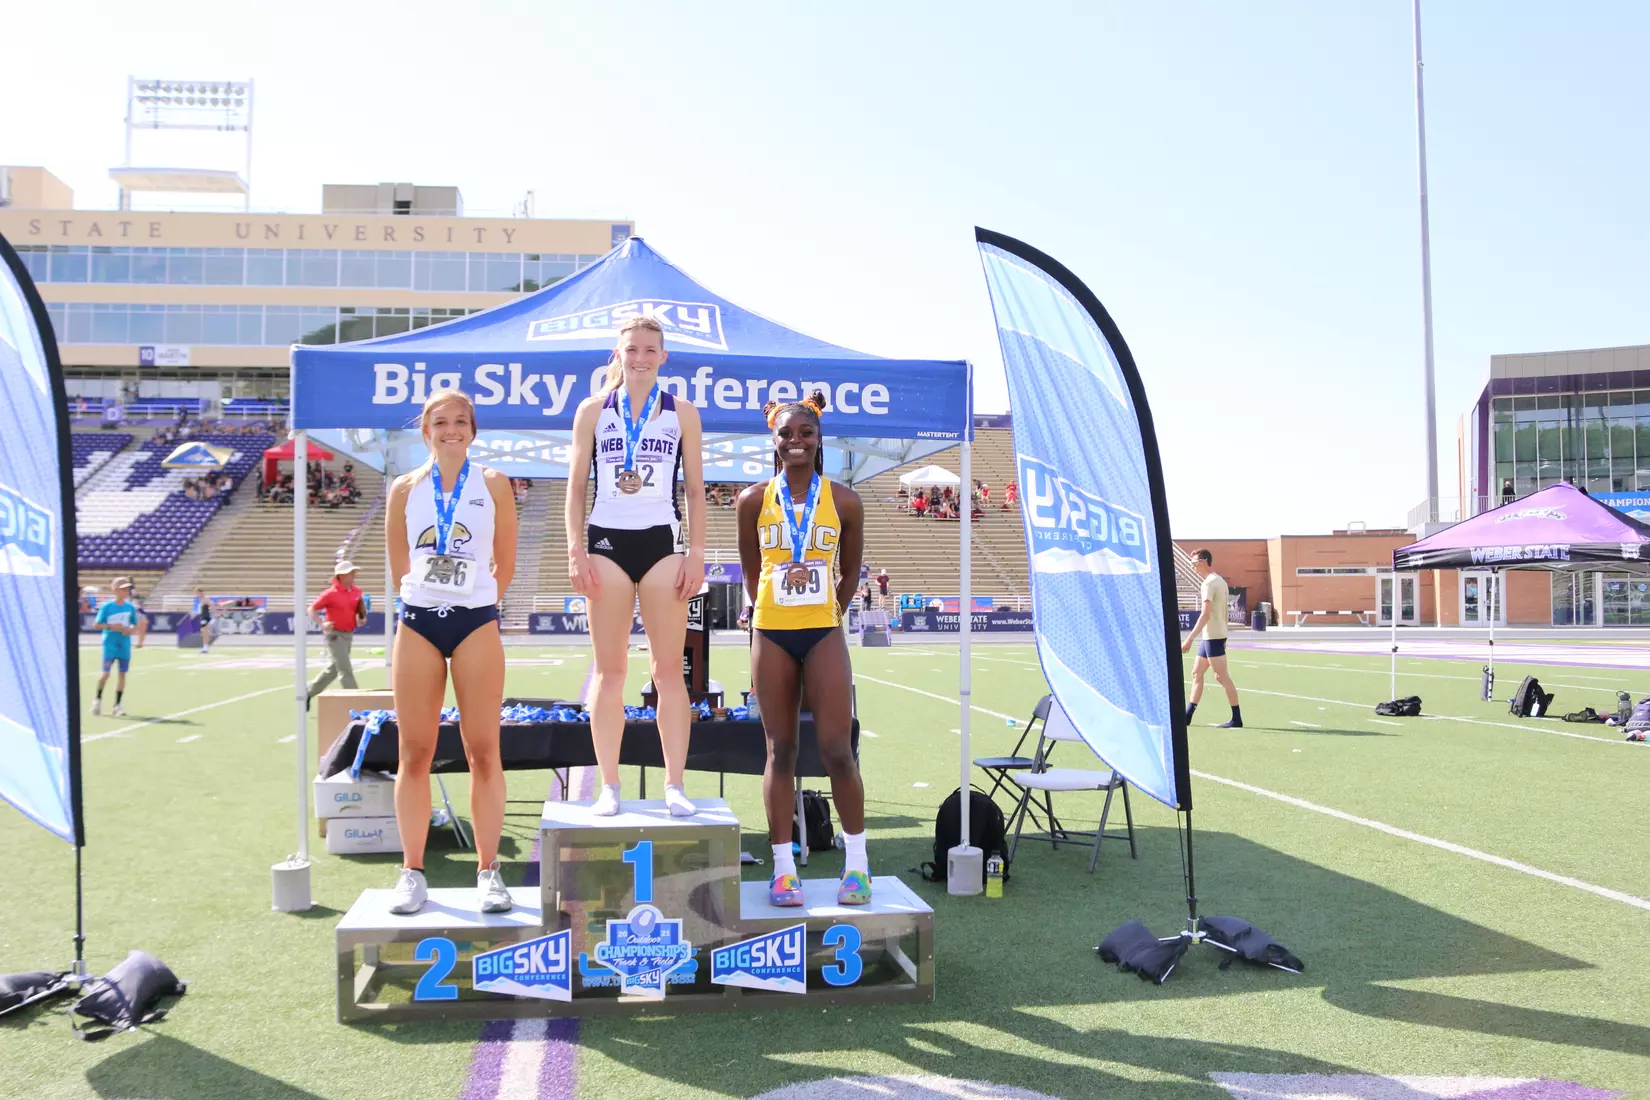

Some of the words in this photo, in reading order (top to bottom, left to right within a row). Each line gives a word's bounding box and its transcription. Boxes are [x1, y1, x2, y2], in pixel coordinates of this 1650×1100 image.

[29, 219, 162, 238] STATE
[235, 222, 517, 245] UNIVERSITY
[475, 363, 577, 416] Sky
[590, 365, 890, 414] nference
[916, 431, 960, 439] MASTERTENT
[601, 438, 623, 453] WEB
[641, 438, 674, 455] STATE
[615, 464, 655, 487] 52
[1469, 546, 1521, 564] WEBER
[1521, 544, 1571, 560] STATE
[424, 557, 468, 587] 26
[970, 615, 988, 623] TATE
[622, 841, 653, 902] 1
[626, 935, 662, 944] Outdoor
[600, 944, 688, 960] CHAMPIONSHIPS
[612, 958, 637, 966] Track
[639, 958, 649, 966] &
[652, 956, 677, 966] Field
[821, 924, 863, 986] 3
[414, 936, 458, 1000] 2
[751, 966, 801, 974] CONFERENCE
